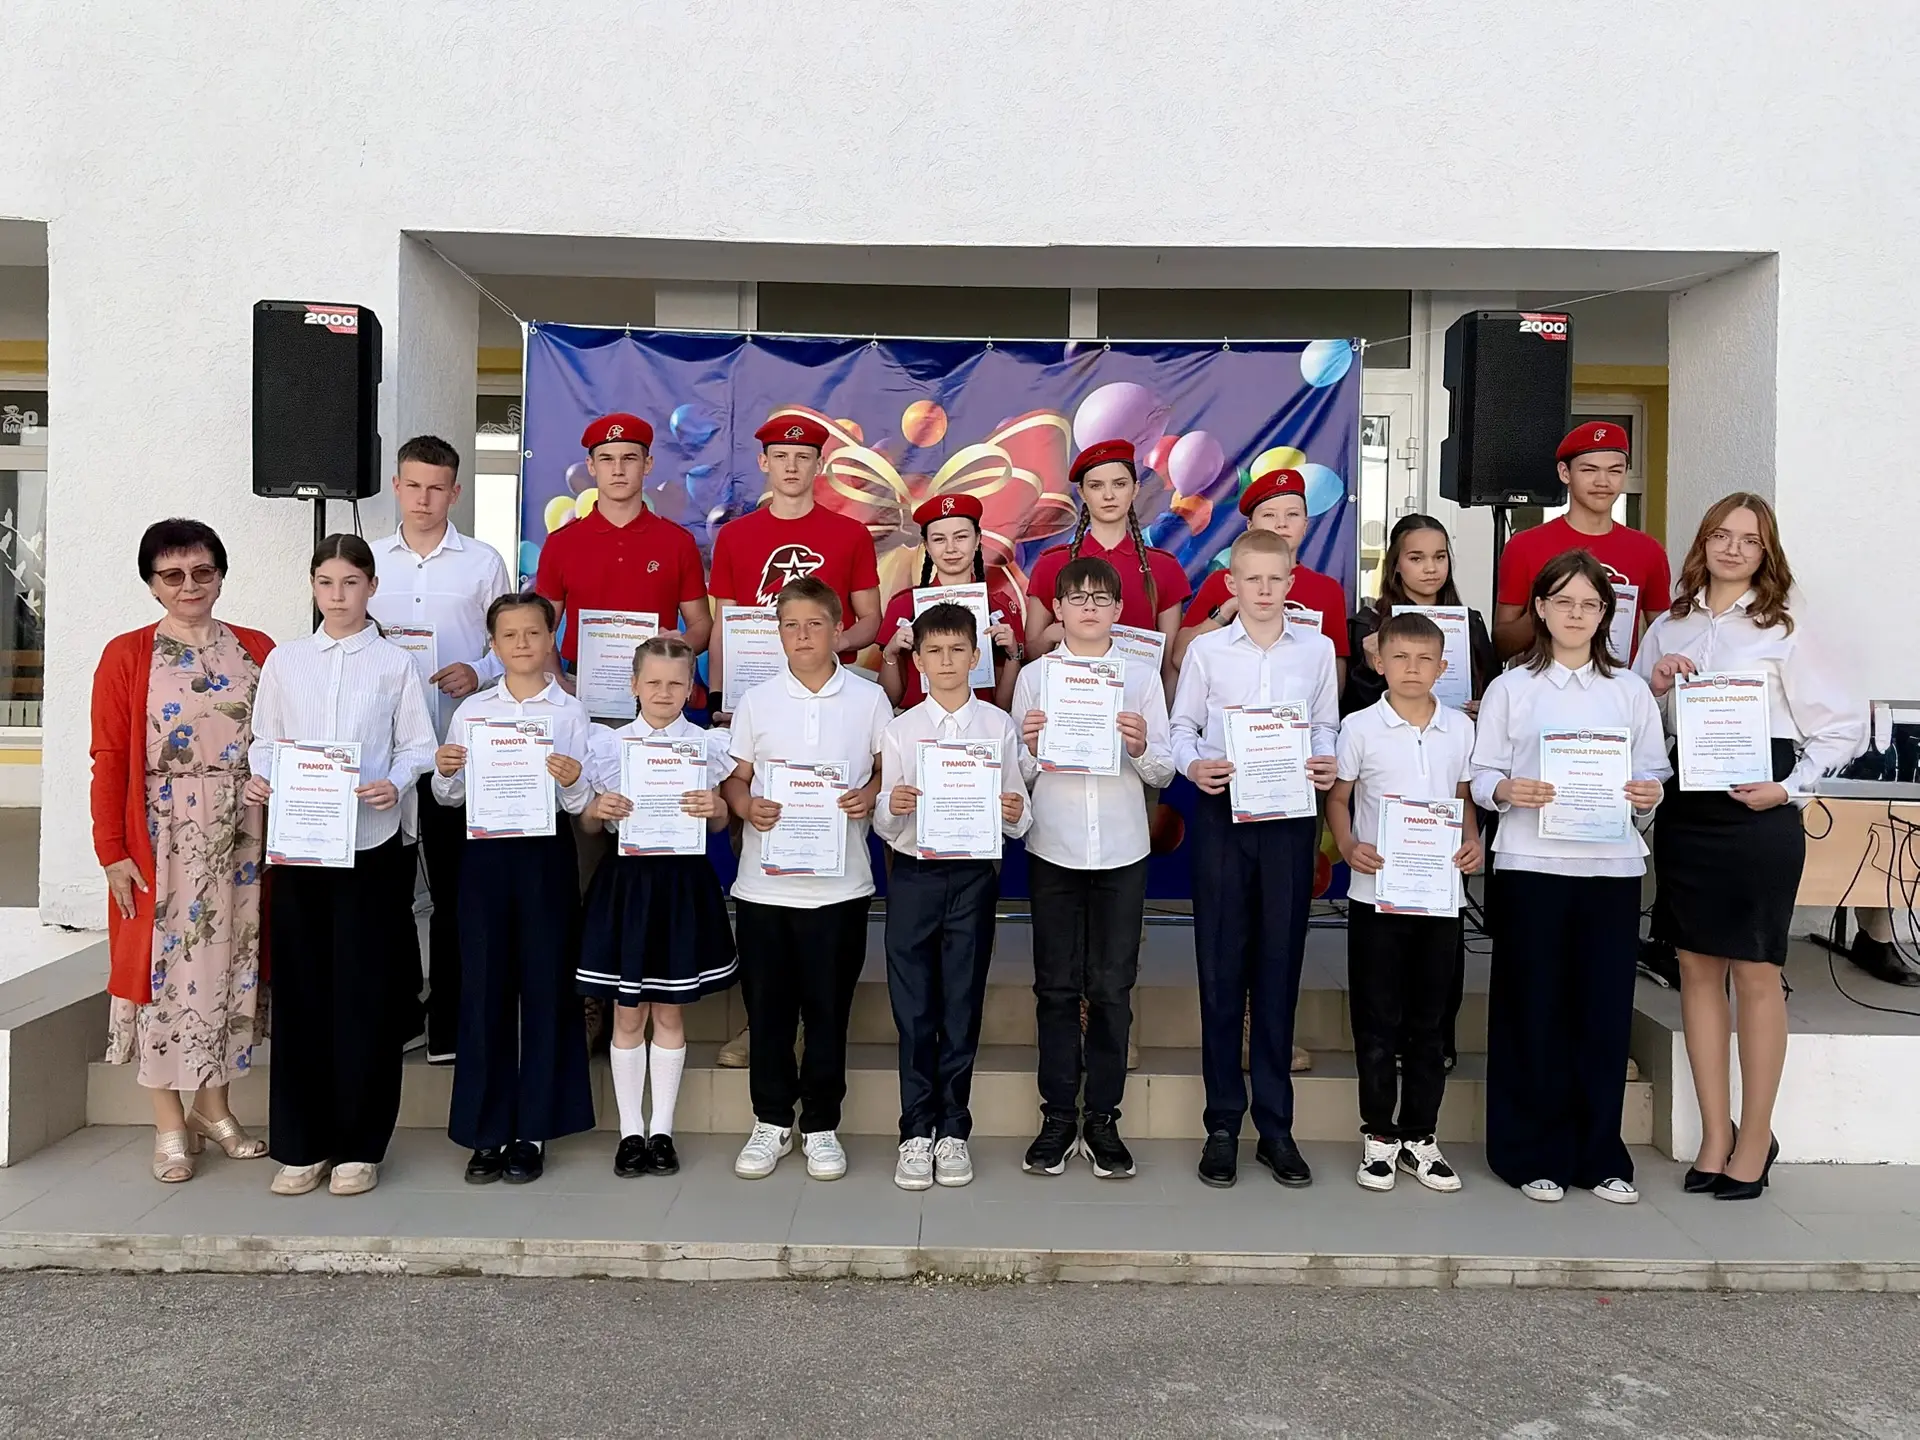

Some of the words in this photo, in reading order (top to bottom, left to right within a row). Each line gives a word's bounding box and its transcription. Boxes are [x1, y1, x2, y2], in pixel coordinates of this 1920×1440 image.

[1065, 677, 1100, 685] ГРАМОТА
[1249, 723, 1284, 732] ГРАМОТА
[490, 738, 528, 746] ГРАМОТА
[297, 762, 334, 771] ГРАМОТА
[1403, 816, 1438, 825] ГРАМОТА
